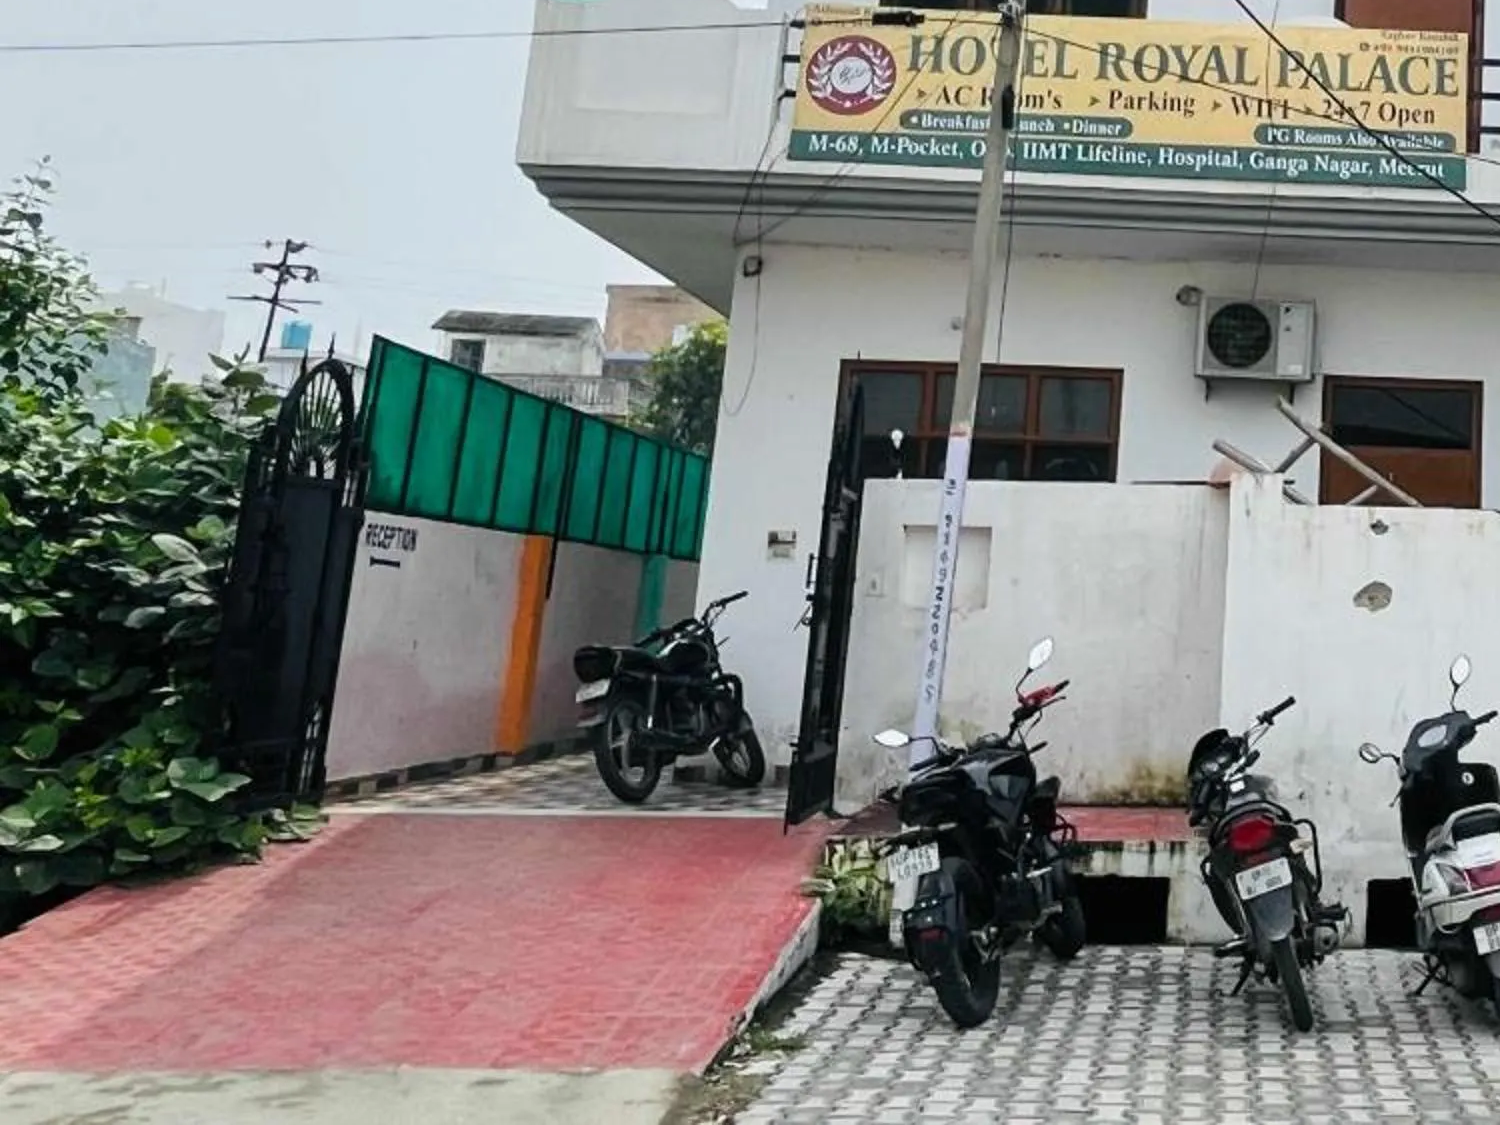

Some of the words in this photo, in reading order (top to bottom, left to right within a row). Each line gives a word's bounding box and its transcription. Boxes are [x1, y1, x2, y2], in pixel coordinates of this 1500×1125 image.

[906, 34, 1078, 80] HOEL
[1093, 40, 1260, 88] ROYAL
[1277, 48, 1460, 97] PALACE
[934, 85, 974, 107] AC
[1108, 89, 1196, 118] Parking
[1231, 94, 1290, 119] WIFI
[1377, 102, 1436, 128] Open
[1072, 119, 1122, 136] Dinner
[1267, 128, 1289, 143] PG
[1293, 129, 1343, 146] Rooms
[1344, 131, 1378, 147] Also
[808, 135, 864, 156] M-68,
[870, 137, 965, 160] M-Pocket,
[1077, 142, 1152, 167] Lifeline,
[1158, 147, 1244, 172] Hospital,
[1250, 150, 1309, 178] Ganga
[1314, 153, 1374, 179] Nagar,
[365, 522, 419, 552] RECEPTION
